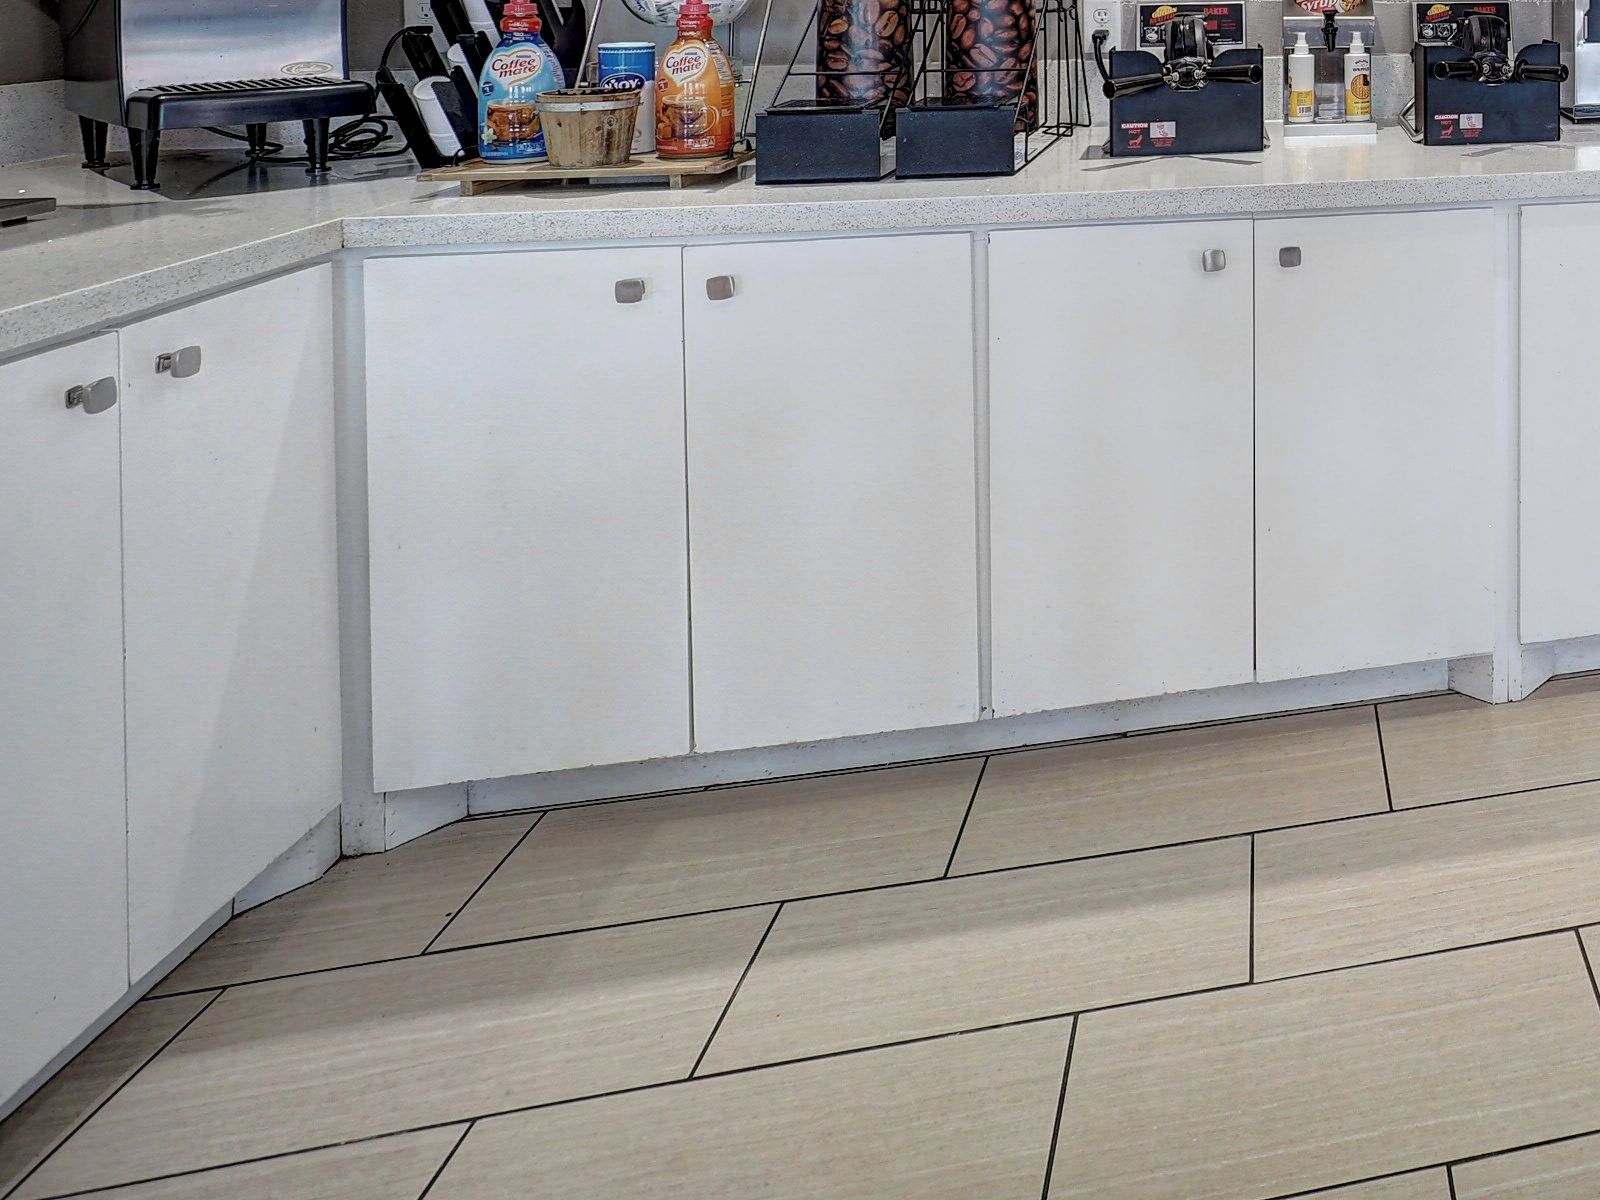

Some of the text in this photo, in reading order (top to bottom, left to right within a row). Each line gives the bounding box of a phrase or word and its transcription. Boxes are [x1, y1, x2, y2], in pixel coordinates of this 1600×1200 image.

[1203, 6, 1229, 16] BAKER
[491, 57, 536, 72] Coffee
[665, 54, 702, 69] Coffee
[671, 61, 702, 76] mate
[498, 64, 537, 79] mate
